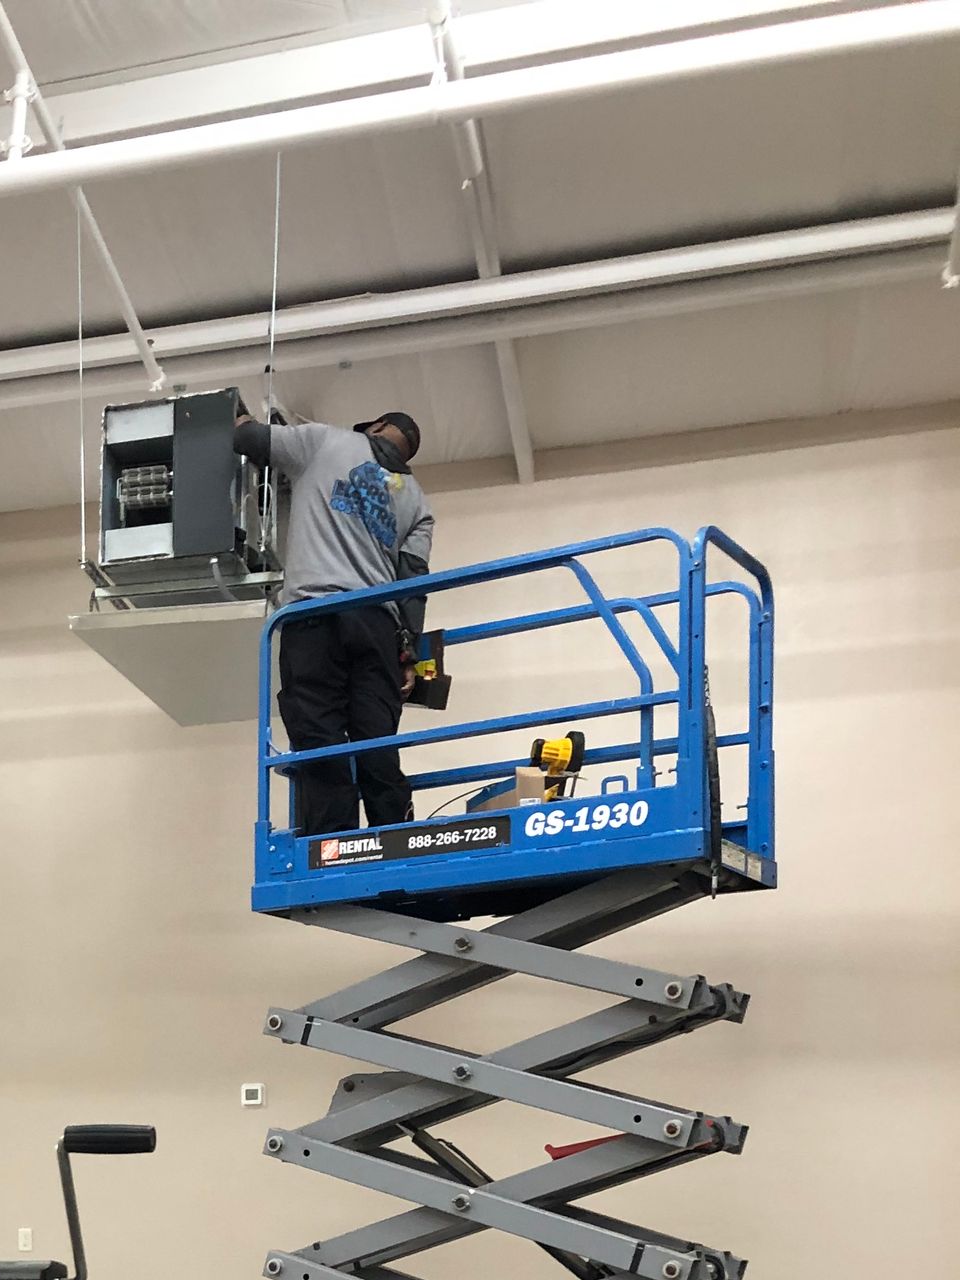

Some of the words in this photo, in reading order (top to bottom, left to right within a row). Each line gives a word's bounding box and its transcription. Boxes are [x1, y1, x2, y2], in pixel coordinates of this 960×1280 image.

[524, 800, 649, 837] GS-1930
[338, 838, 383, 855] RENTAL
[408, 826, 497, 849] 888-266-7228
